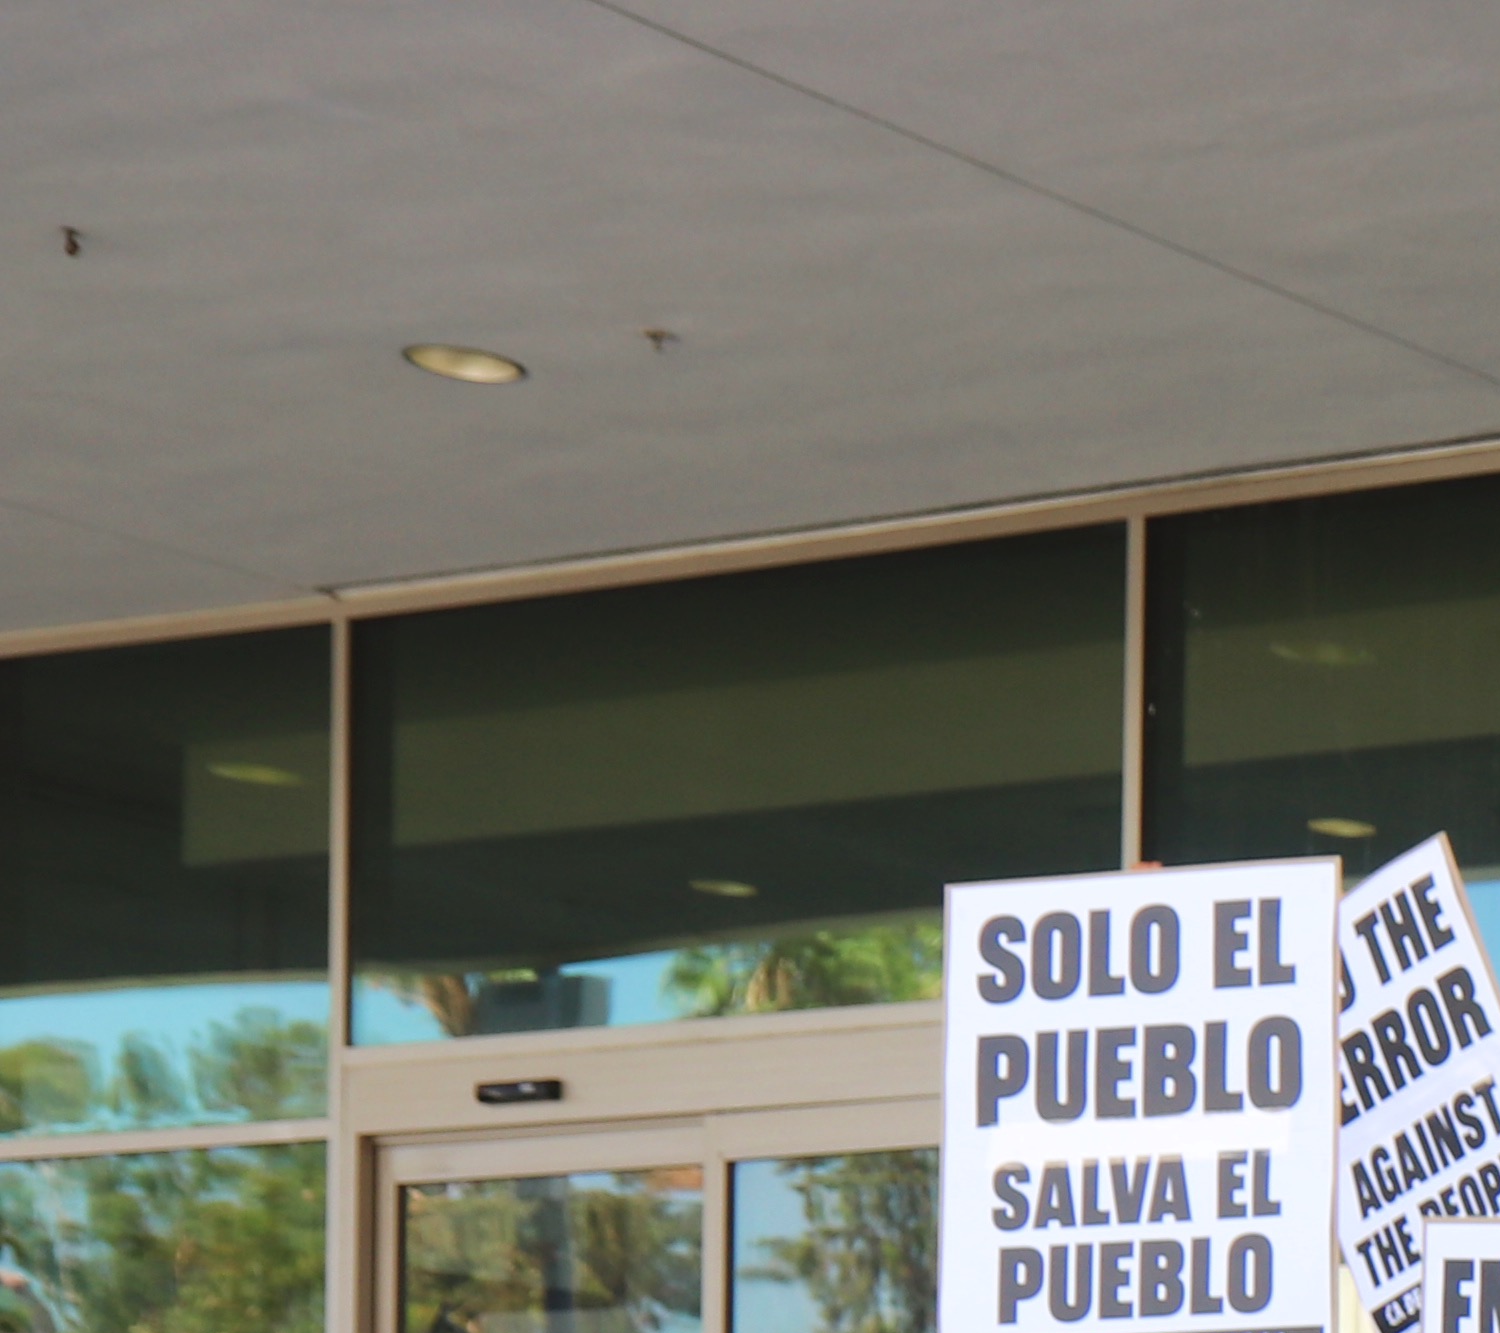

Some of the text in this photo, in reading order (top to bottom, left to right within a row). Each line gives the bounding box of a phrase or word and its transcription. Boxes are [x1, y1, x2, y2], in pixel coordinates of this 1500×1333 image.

[976, 905, 1180, 1004] SOLO
[1212, 897, 1296, 989] EL
[1354, 872, 1456, 985] THE
[976, 1015, 1303, 1126] PUEBLO
[1341, 965, 1494, 1126] ERROR
[991, 1149, 1281, 1231] SALVA EL
[999, 1232, 1274, 1324] PUEBLO
[1356, 1214, 1421, 1288] THE
